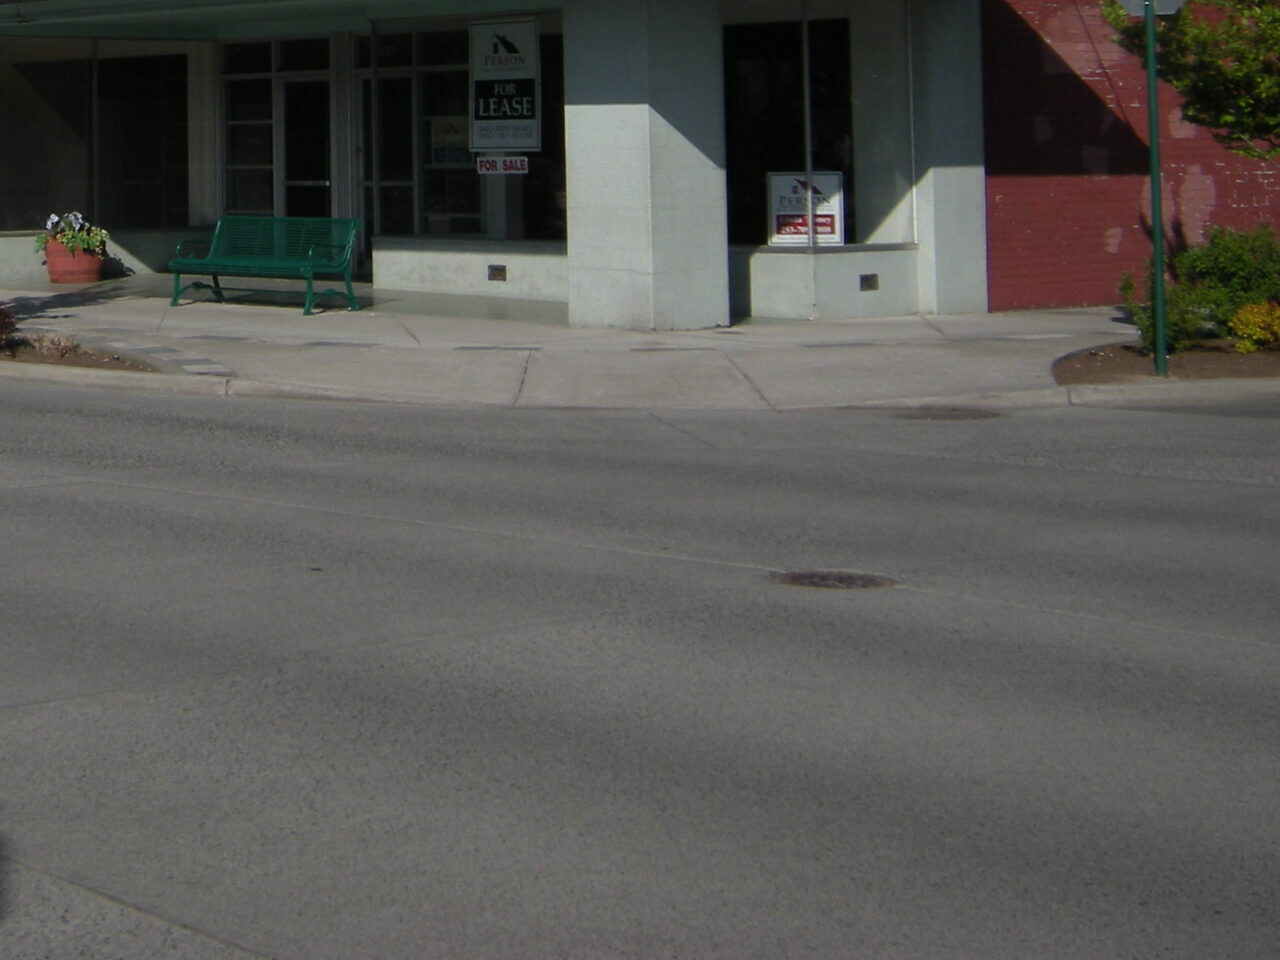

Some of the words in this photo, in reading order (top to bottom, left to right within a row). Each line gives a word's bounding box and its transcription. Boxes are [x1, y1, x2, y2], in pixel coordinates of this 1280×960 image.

[484, 54, 525, 66] PERSON
[494, 83, 517, 95] FOR
[479, 97, 532, 116] LEASE
[479, 159, 498, 172] FOR
[502, 159, 527, 172] SALE
